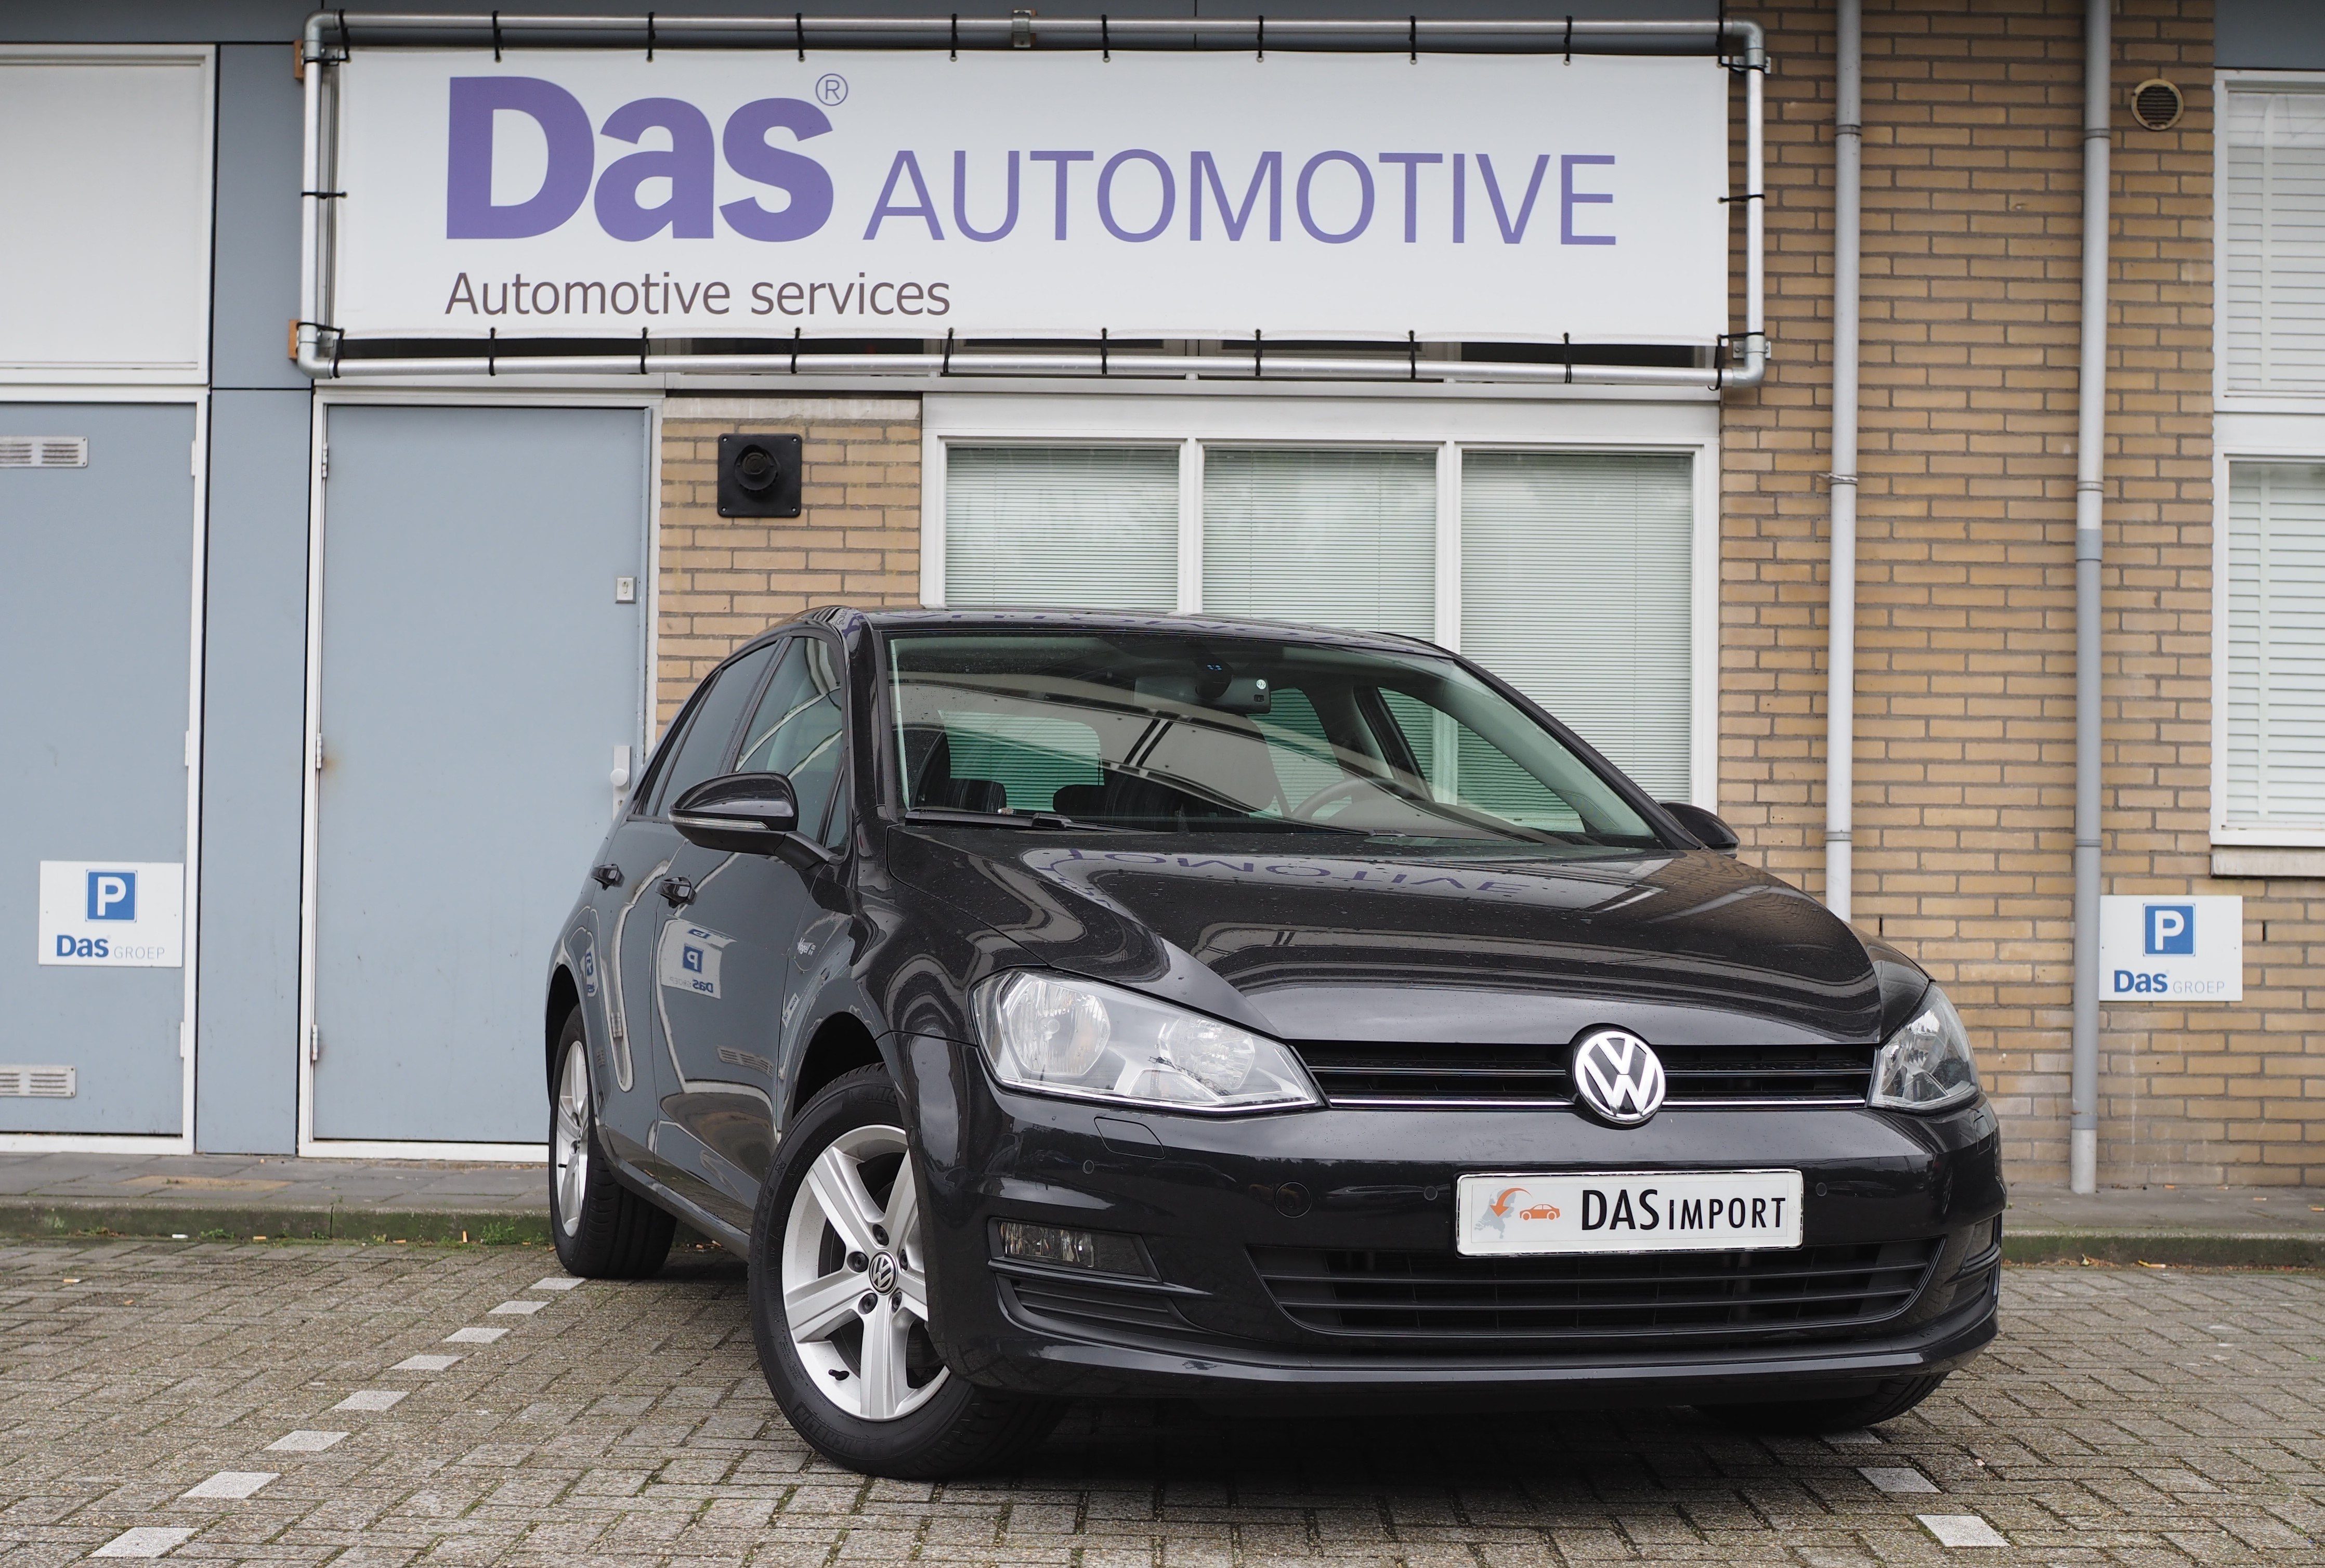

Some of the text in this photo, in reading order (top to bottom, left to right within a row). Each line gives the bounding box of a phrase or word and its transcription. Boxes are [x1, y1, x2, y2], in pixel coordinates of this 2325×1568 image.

[862, 148, 1617, 245] AUTOMOTIVE
[445, 272, 951, 316] Automotive services
[97, 876, 126, 916] P
[56, 934, 165, 960] Das GROEP
[2155, 910, 2184, 950] P
[2114, 970, 2225, 994] Das GROEP
[1581, 1188, 1786, 1231] DAS IMPORT
